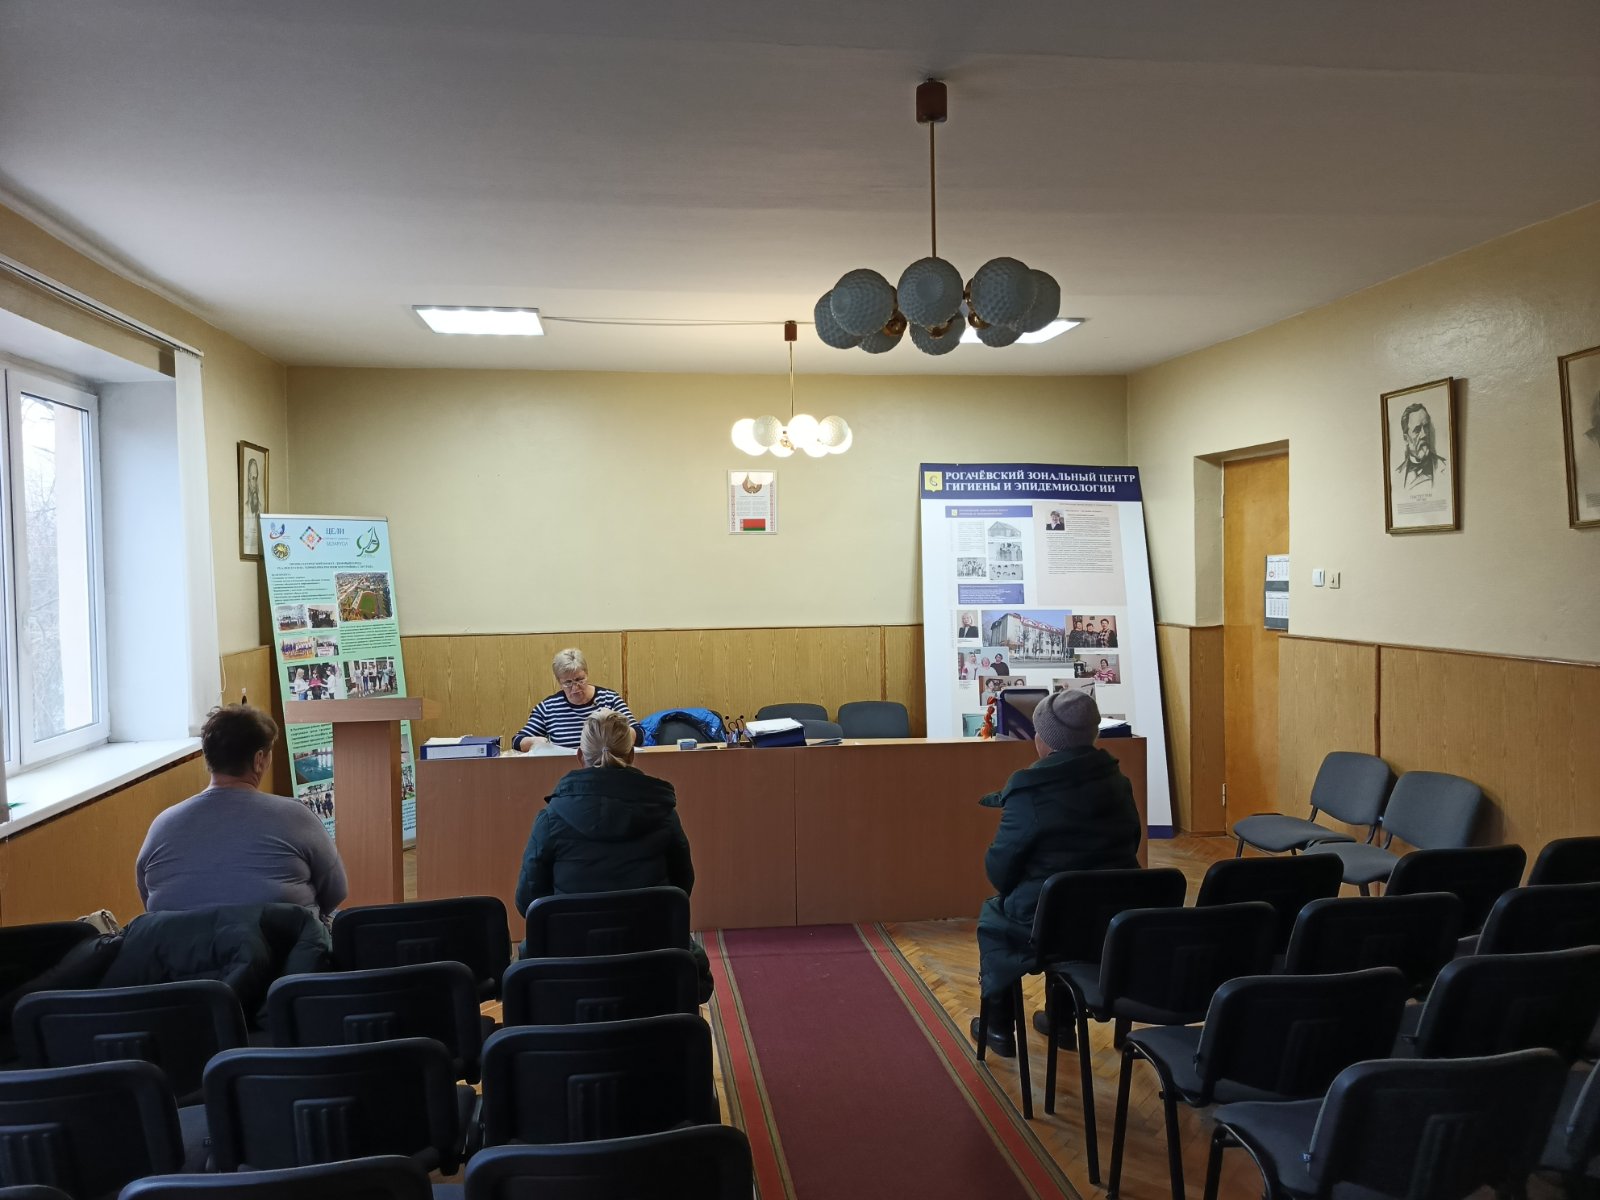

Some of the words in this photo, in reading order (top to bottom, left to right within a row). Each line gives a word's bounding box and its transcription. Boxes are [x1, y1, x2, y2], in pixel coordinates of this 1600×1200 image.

[945, 470, 1025, 480] РОГАЧЁВСКИЙ
[1026, 471, 1097, 482] ЗОНАЛЬНЫЙ
[1099, 474, 1136, 484] ЦЕНТР
[945, 482, 1001, 491] ГИГИЕНЫ
[1003, 482, 1012, 491] И
[1014, 482, 1116, 493] ЭПИДЕМИОЛОГИИ
